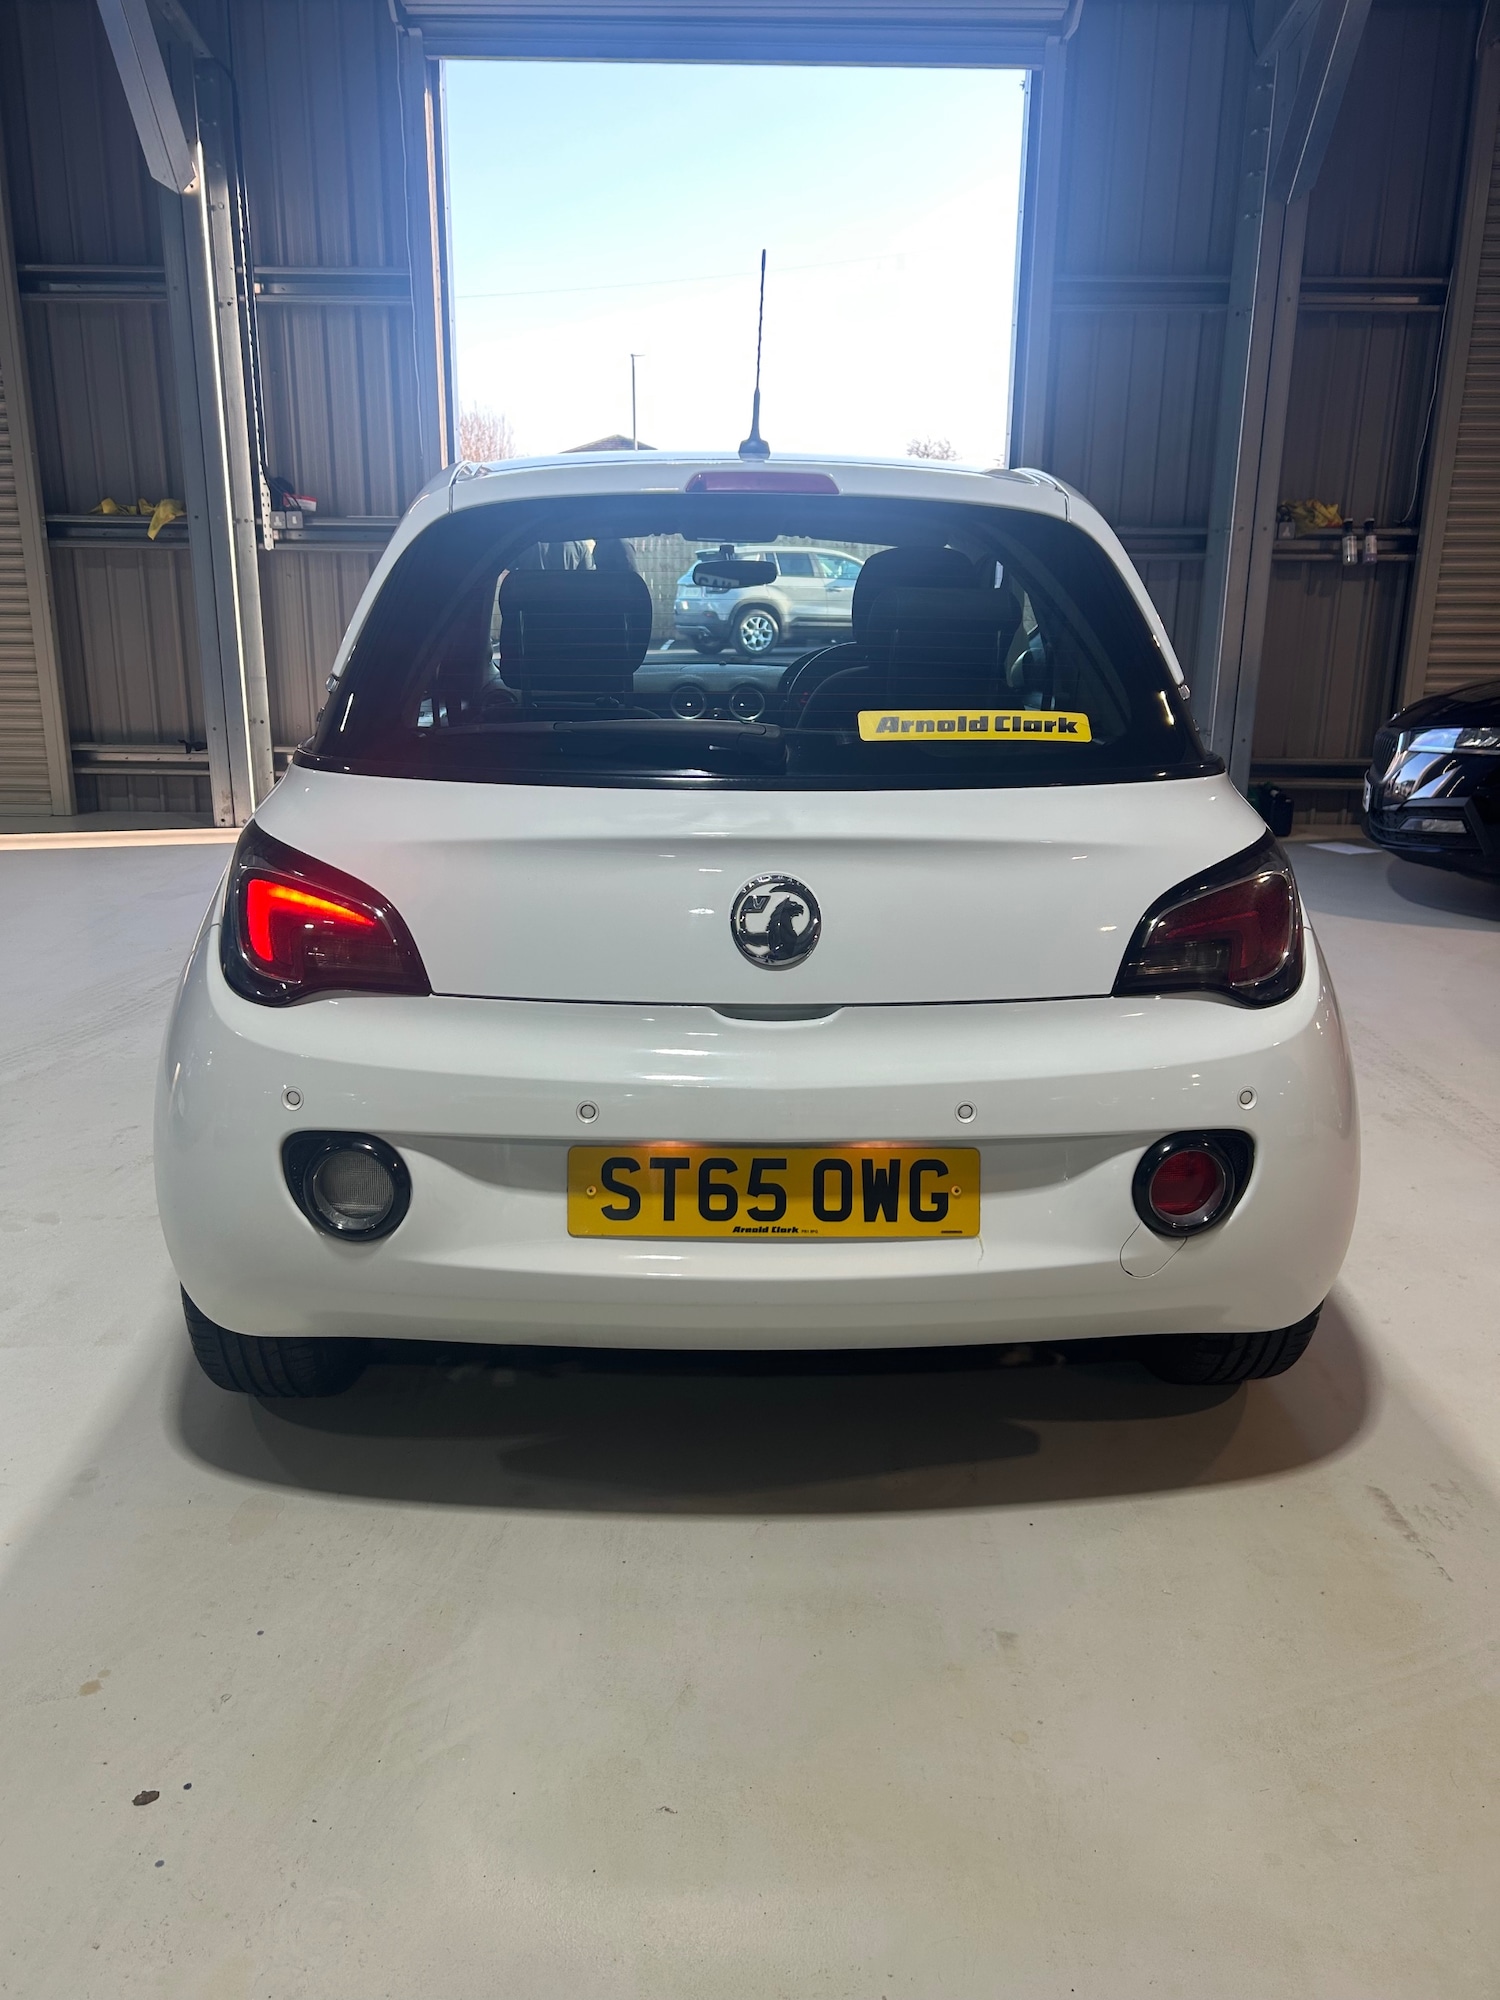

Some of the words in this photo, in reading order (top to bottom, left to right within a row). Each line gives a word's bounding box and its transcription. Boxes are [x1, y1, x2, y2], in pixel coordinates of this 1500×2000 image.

[875, 715, 989, 733] Arnold
[994, 716, 1079, 734] Clark
[600, 1156, 788, 1222] ST65
[811, 1158, 950, 1224] OWG
[732, 1226, 769, 1234] Arnold
[771, 1226, 799, 1234] Clark
